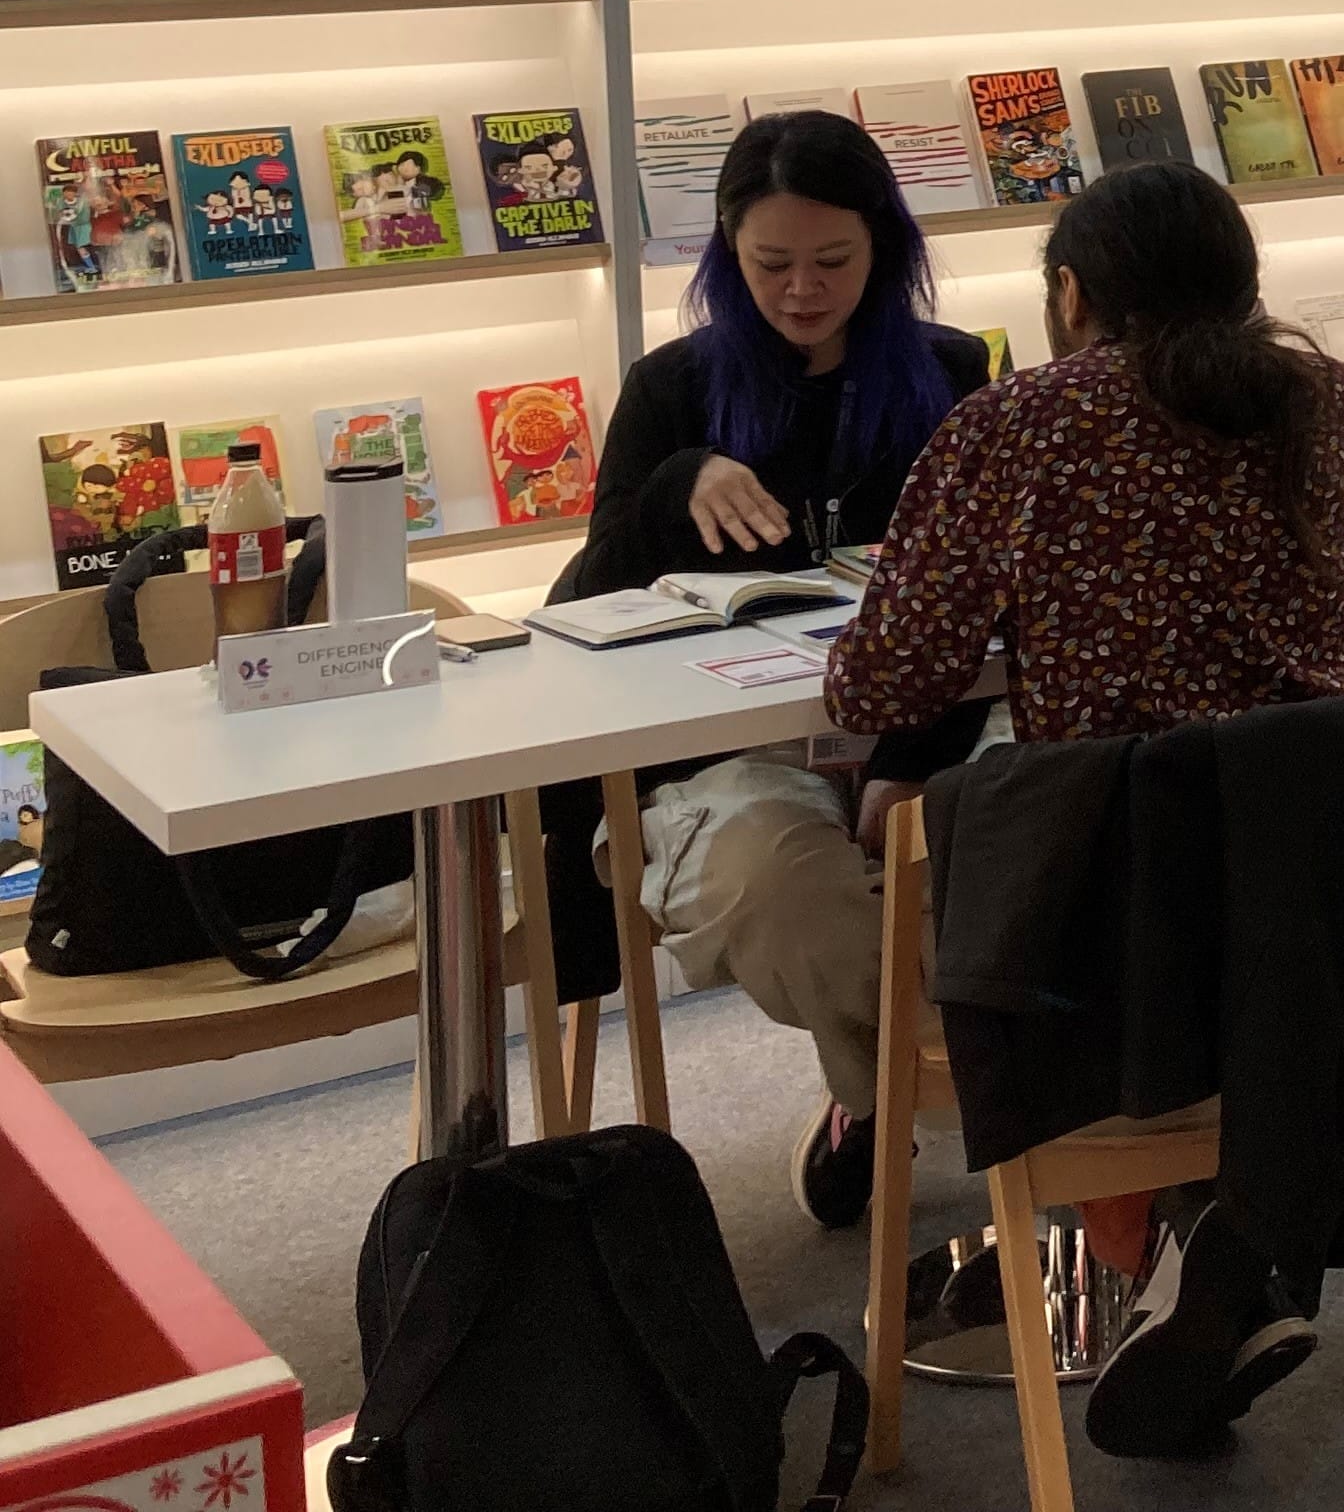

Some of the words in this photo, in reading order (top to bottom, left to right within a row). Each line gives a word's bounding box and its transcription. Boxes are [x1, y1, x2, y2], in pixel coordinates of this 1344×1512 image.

[971, 70, 1059, 103] SHERLOCK
[977, 95, 1042, 127] SAM'S
[1115, 95, 1162, 118] FIB
[484, 117, 574, 144] EXLOSERS
[644, 128, 710, 142] RETALIATE
[65, 137, 138, 159] AWFUL
[895, 137, 934, 149] RESIST
[496, 202, 572, 224] CAPTIVE
[573, 199, 594, 216] IN
[502, 218, 541, 238] THE
[543, 215, 592, 232] DARK
[366, 438, 392, 450] THE
[67, 550, 120, 574] BONE
[297, 638, 404, 665] DIFFERENC
